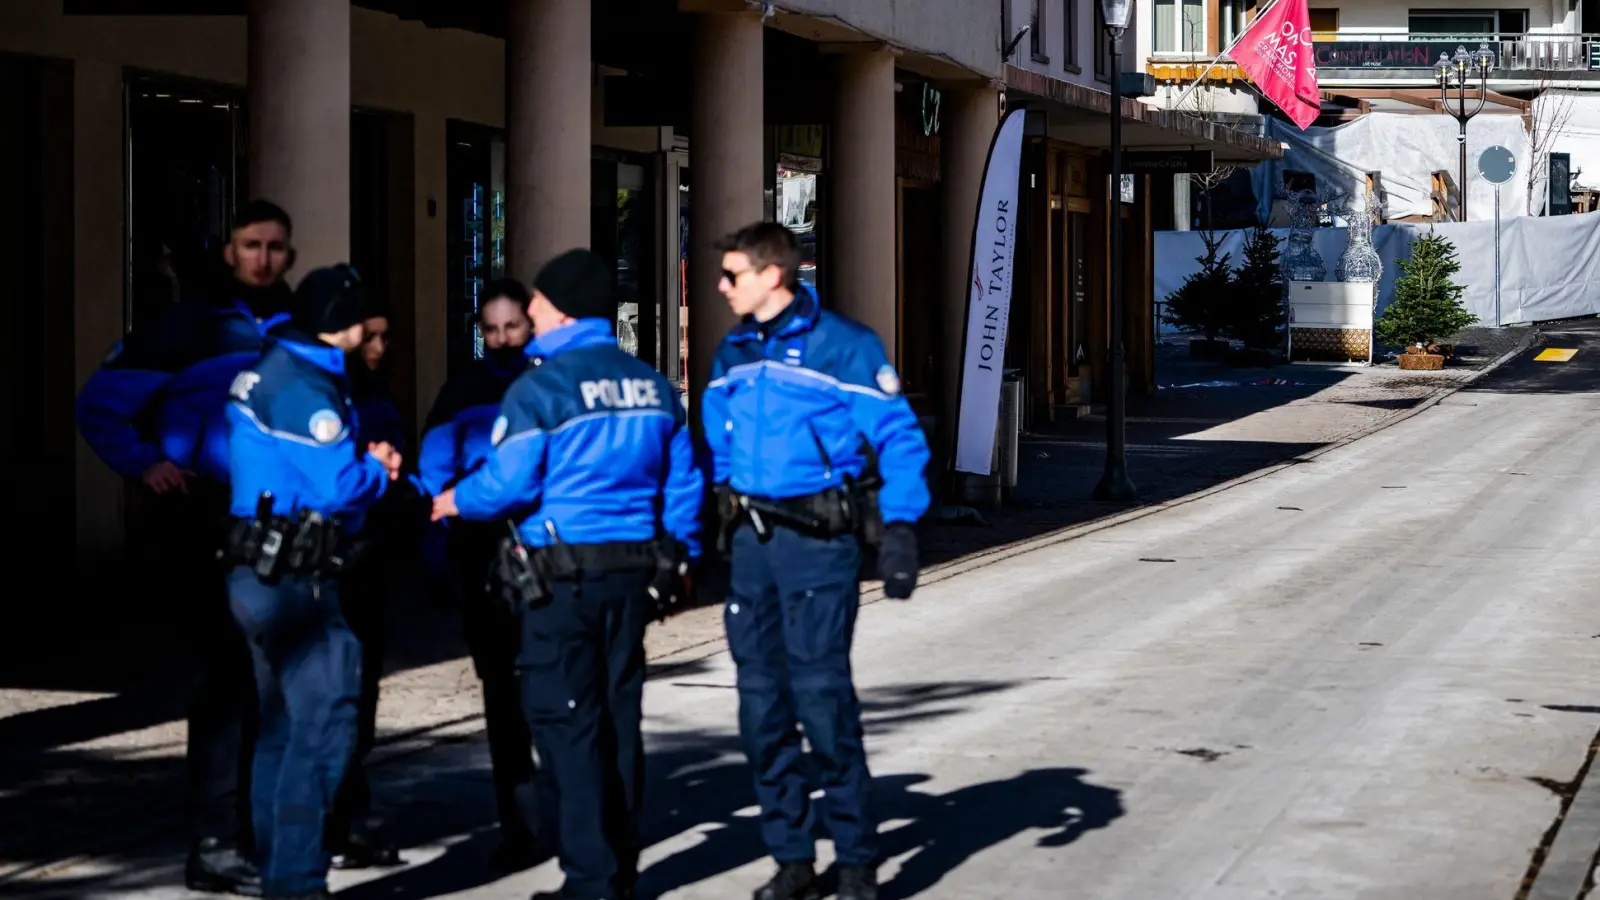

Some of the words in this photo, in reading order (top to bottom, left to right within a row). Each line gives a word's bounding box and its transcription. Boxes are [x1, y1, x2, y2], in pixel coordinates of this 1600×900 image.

[988, 199, 1009, 296] TAYLOR
[978, 305, 1000, 372] JOHN
[580, 378, 661, 410] POLICE
